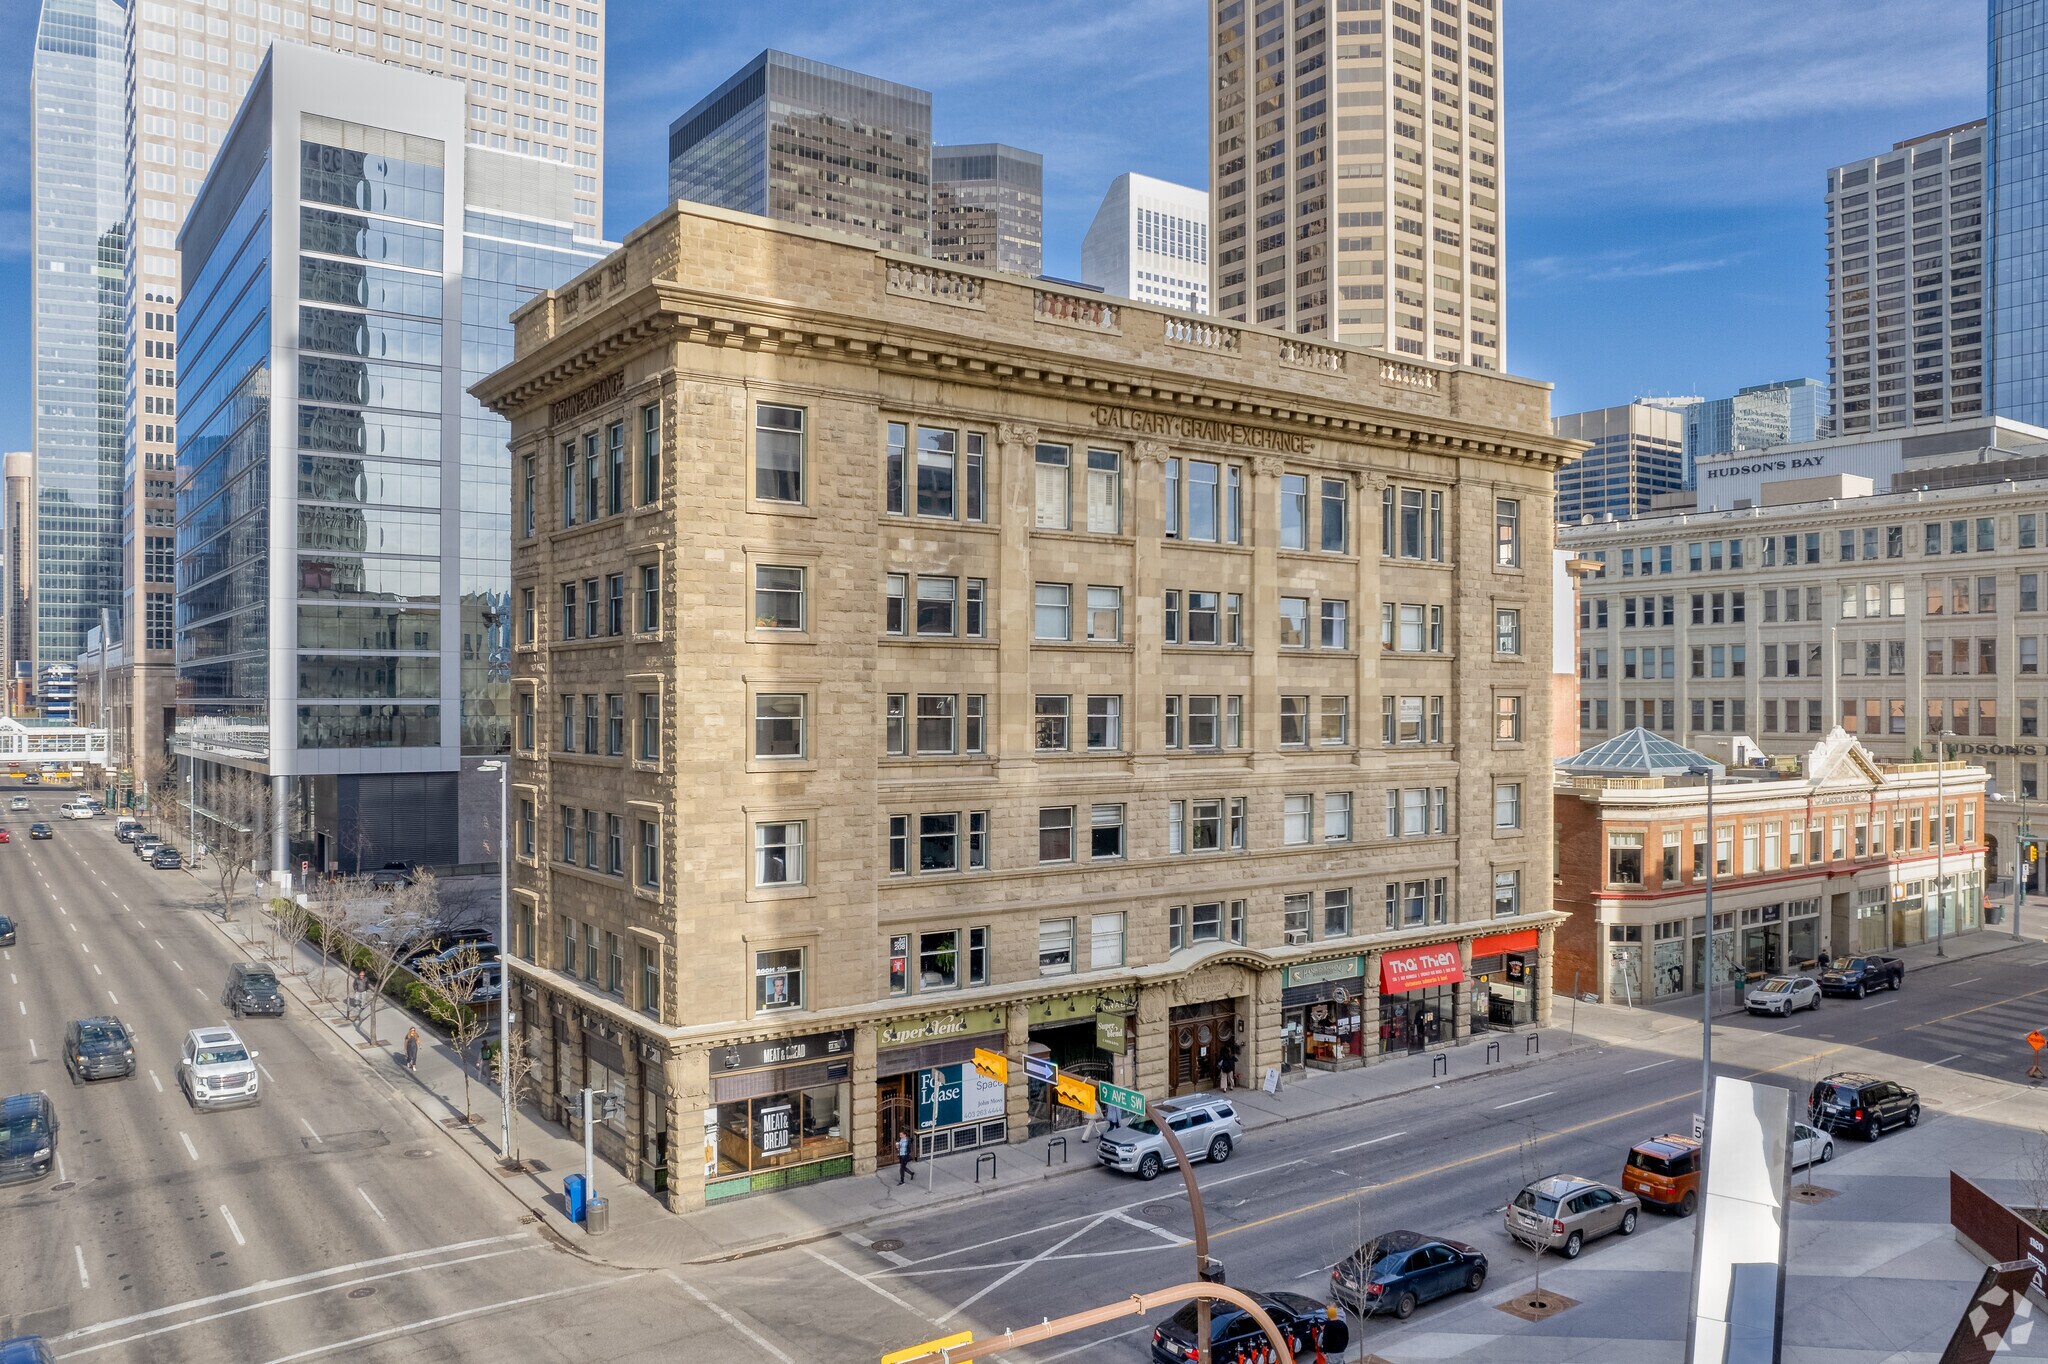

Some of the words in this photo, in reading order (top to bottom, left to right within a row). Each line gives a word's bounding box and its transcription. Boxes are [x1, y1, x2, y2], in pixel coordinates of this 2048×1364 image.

[1096, 405, 1175, 434] CALGARY
[1180, 417, 1228, 442] GRAIN
[1231, 423, 1311, 454] EXCHANGE
[1707, 460, 1786, 479] HUDSON'S
[1791, 456, 1825, 469] BAY
[1419, 952, 1455, 969] Thien
[1090, 999, 1137, 1013] CNNAB
[763, 1048, 781, 1063] MEAT
[780, 1049, 786, 1060] &
[921, 1074, 943, 1090] Fo
[976, 1079, 1003, 1091] Space
[1101, 1086, 1108, 1098] 9
[1111, 1090, 1127, 1105] AVE
[1131, 1095, 1143, 1110] SW
[964, 1109, 976, 1119] 403
[763, 1130, 789, 1150] BREAD
